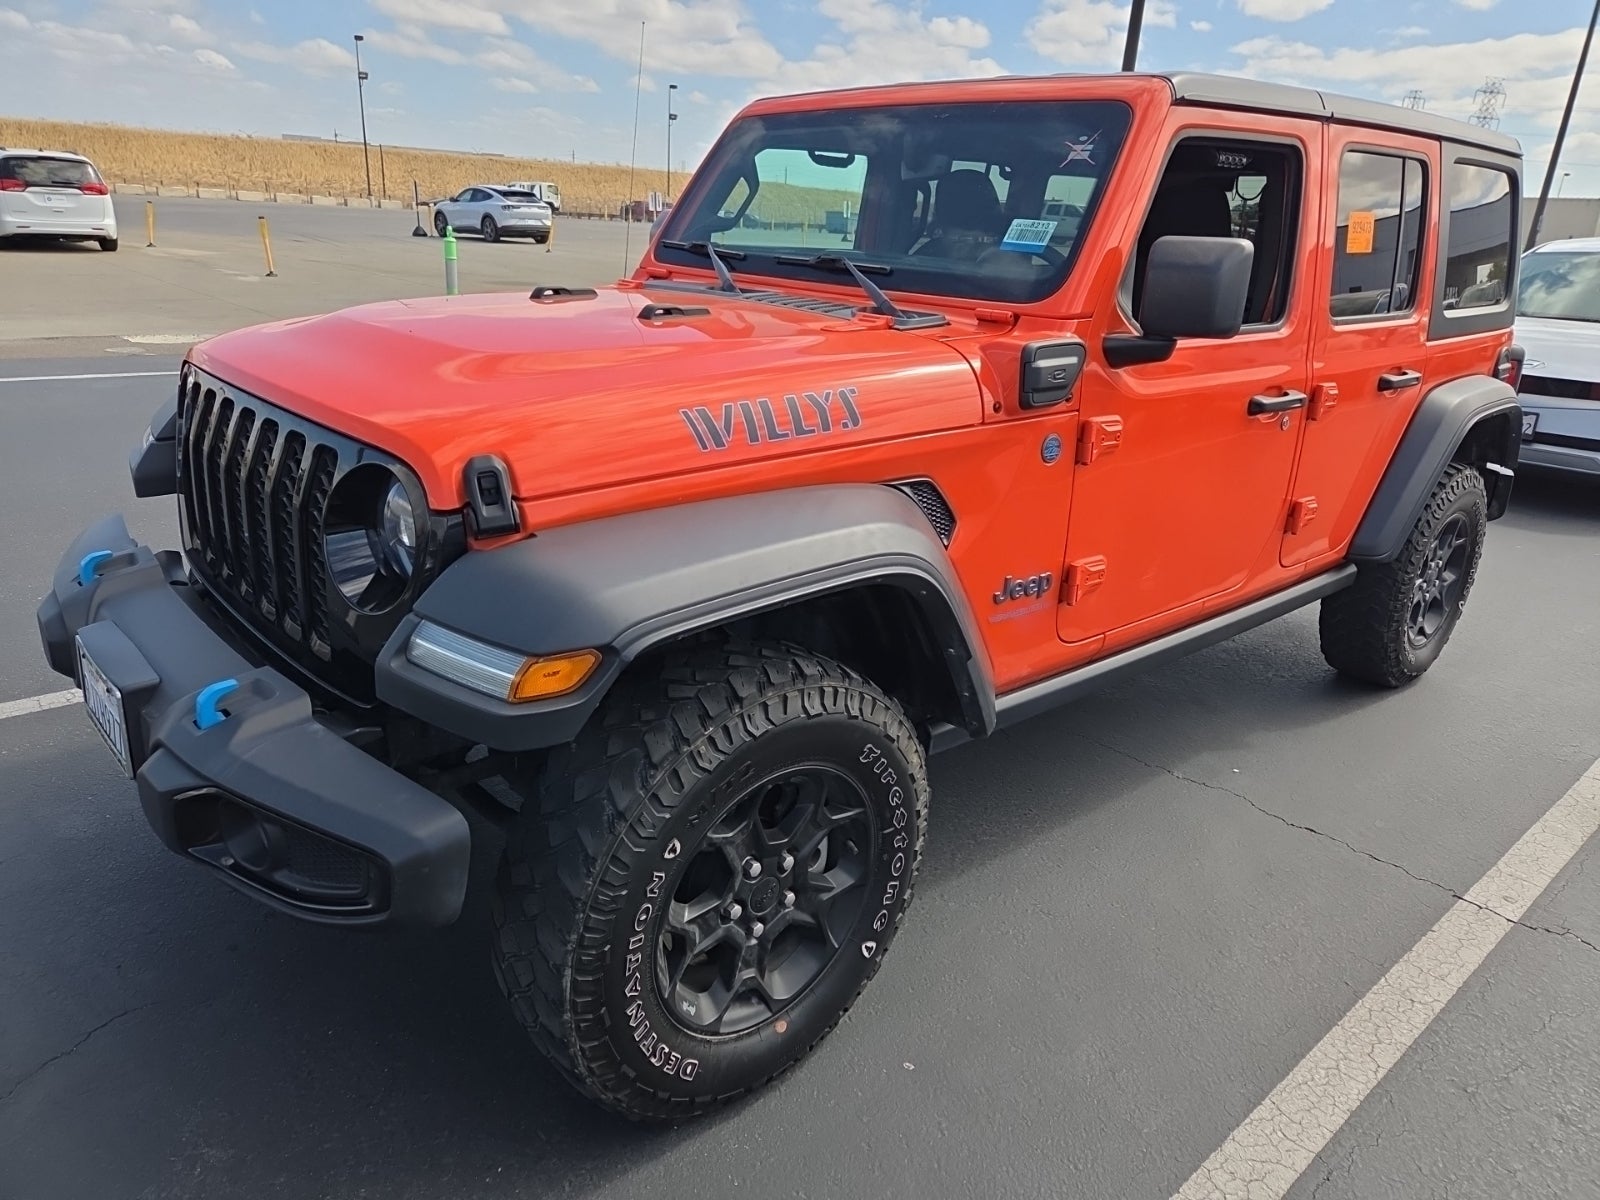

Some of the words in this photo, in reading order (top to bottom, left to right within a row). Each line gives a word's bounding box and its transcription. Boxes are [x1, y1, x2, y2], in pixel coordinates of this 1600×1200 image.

[678, 386, 863, 453] WILLYS
[992, 572, 1053, 605] Jeep
[859, 743, 909, 932] Firestone
[624, 871, 699, 1081] DESTINATION
